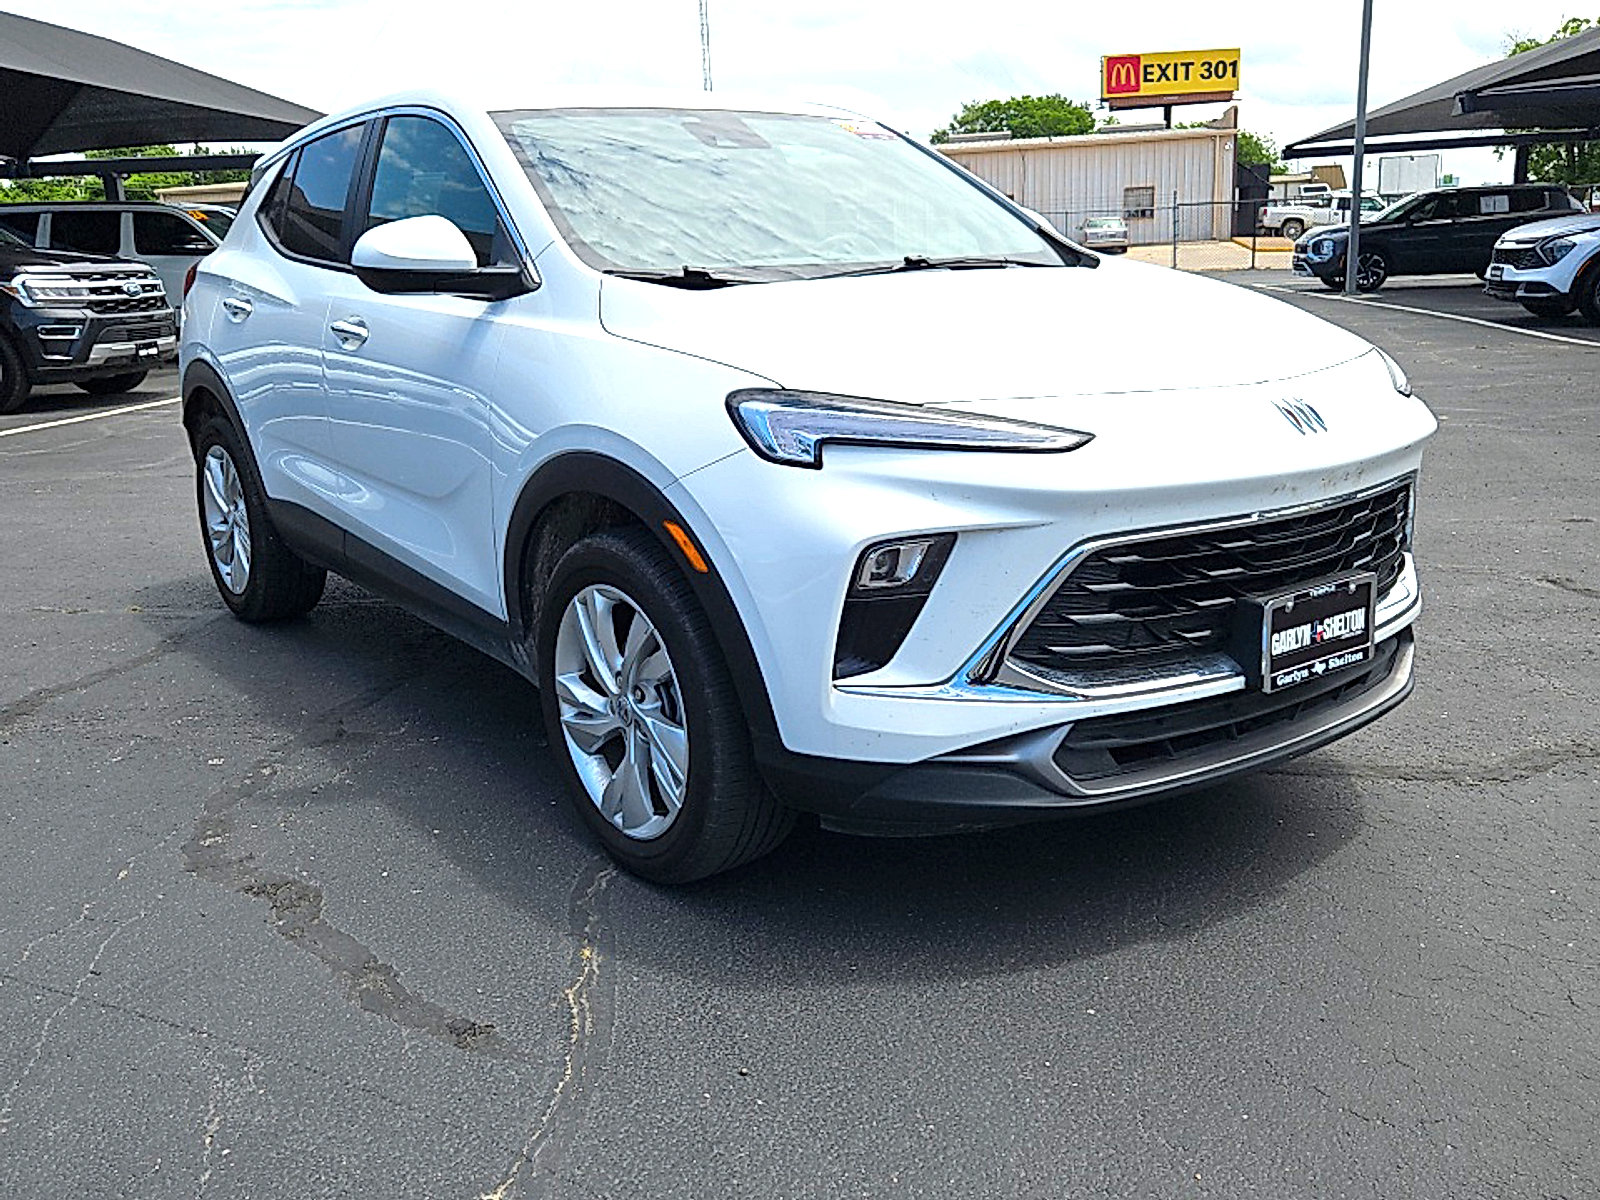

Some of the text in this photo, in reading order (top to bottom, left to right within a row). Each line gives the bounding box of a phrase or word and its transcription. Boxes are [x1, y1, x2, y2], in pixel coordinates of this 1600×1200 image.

[1142, 59, 1238, 83] EXIT 301
[1271, 606, 1366, 656] GARLYN SHELTON
[1328, 651, 1364, 670] Shelton
